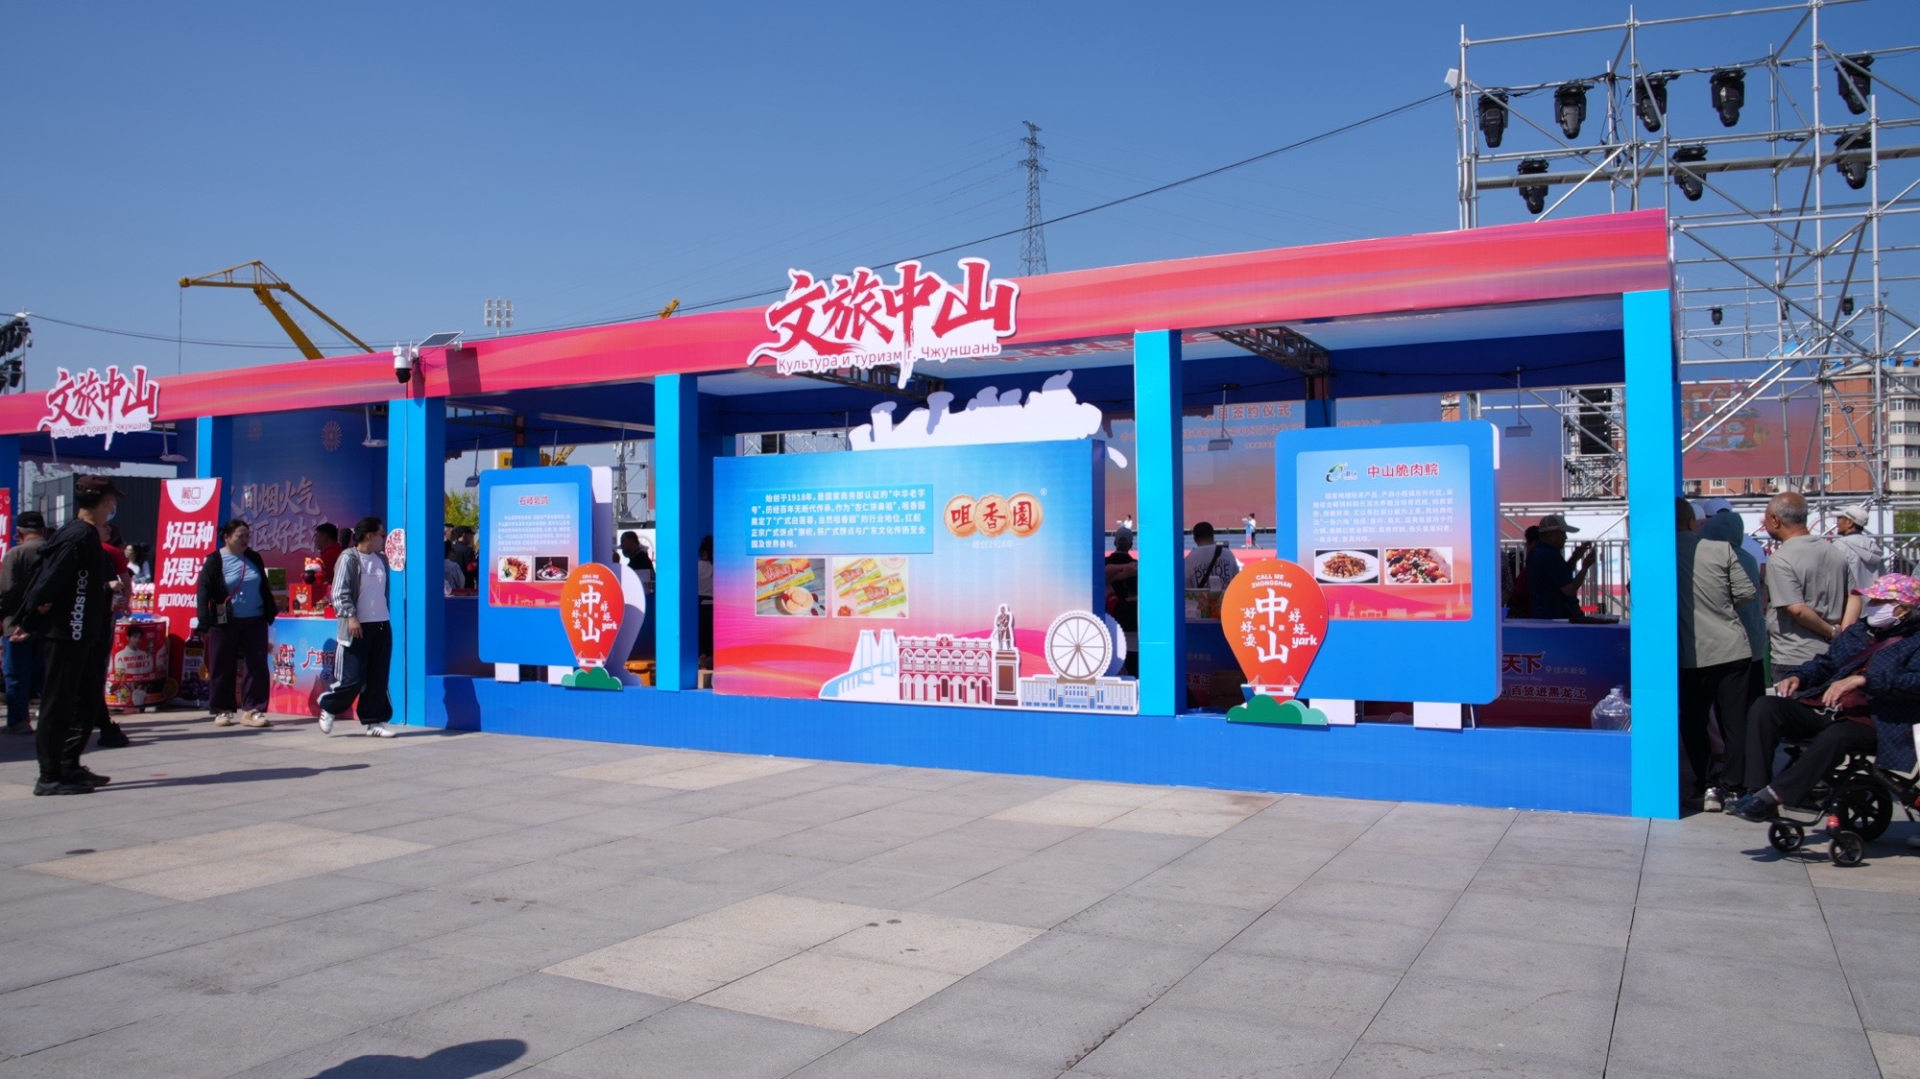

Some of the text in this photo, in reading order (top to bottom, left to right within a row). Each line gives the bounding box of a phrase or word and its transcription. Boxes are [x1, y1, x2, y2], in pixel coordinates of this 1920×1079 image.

[756, 261, 1016, 357] 文旅中山
[778, 356, 838, 372] Культура
[842, 356, 851, 366] и
[854, 351, 903, 369] туризм
[920, 343, 1000, 359] Чжуншань
[48, 366, 158, 427] 文旅中山
[1205, 402, 1291, 420] 目签约仪式
[162, 521, 215, 555] 好品种
[70, 596, 86, 641] adidas
[581, 584, 601, 643] 中山
[1255, 587, 1289, 664] 中山
[1291, 634, 1318, 649] yark
[1501, 651, 1546, 675] 天下
